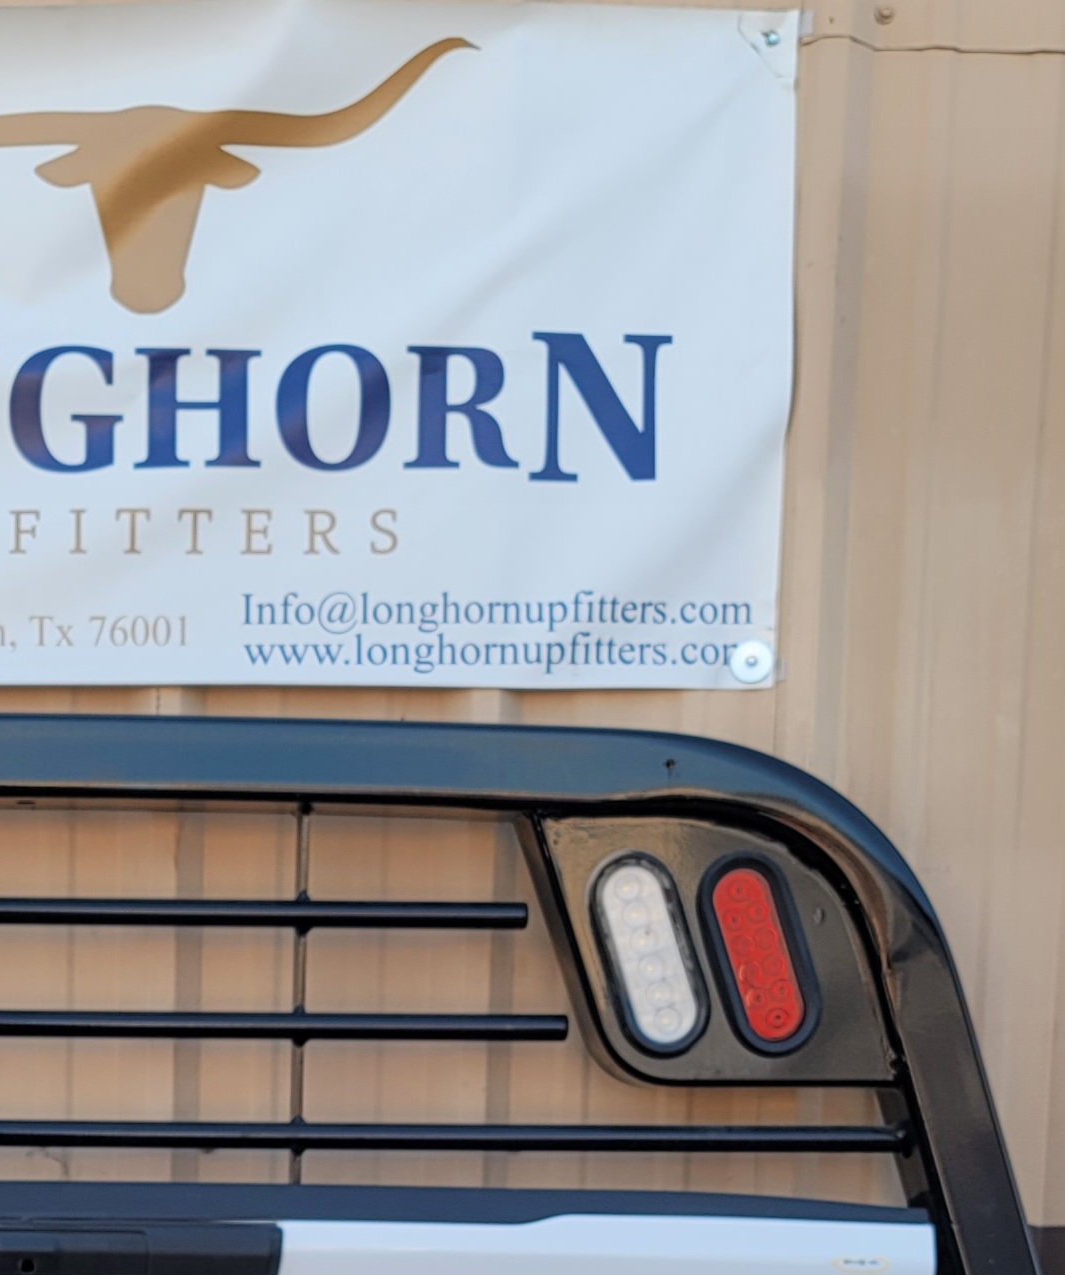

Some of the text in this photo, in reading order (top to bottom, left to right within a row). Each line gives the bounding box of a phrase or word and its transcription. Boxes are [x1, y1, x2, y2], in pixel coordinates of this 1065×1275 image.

[29, 616, 75, 647] Tx
[88, 615, 189, 647] 76001
[242, 590, 753, 634] Info@longhornupfitters.com
